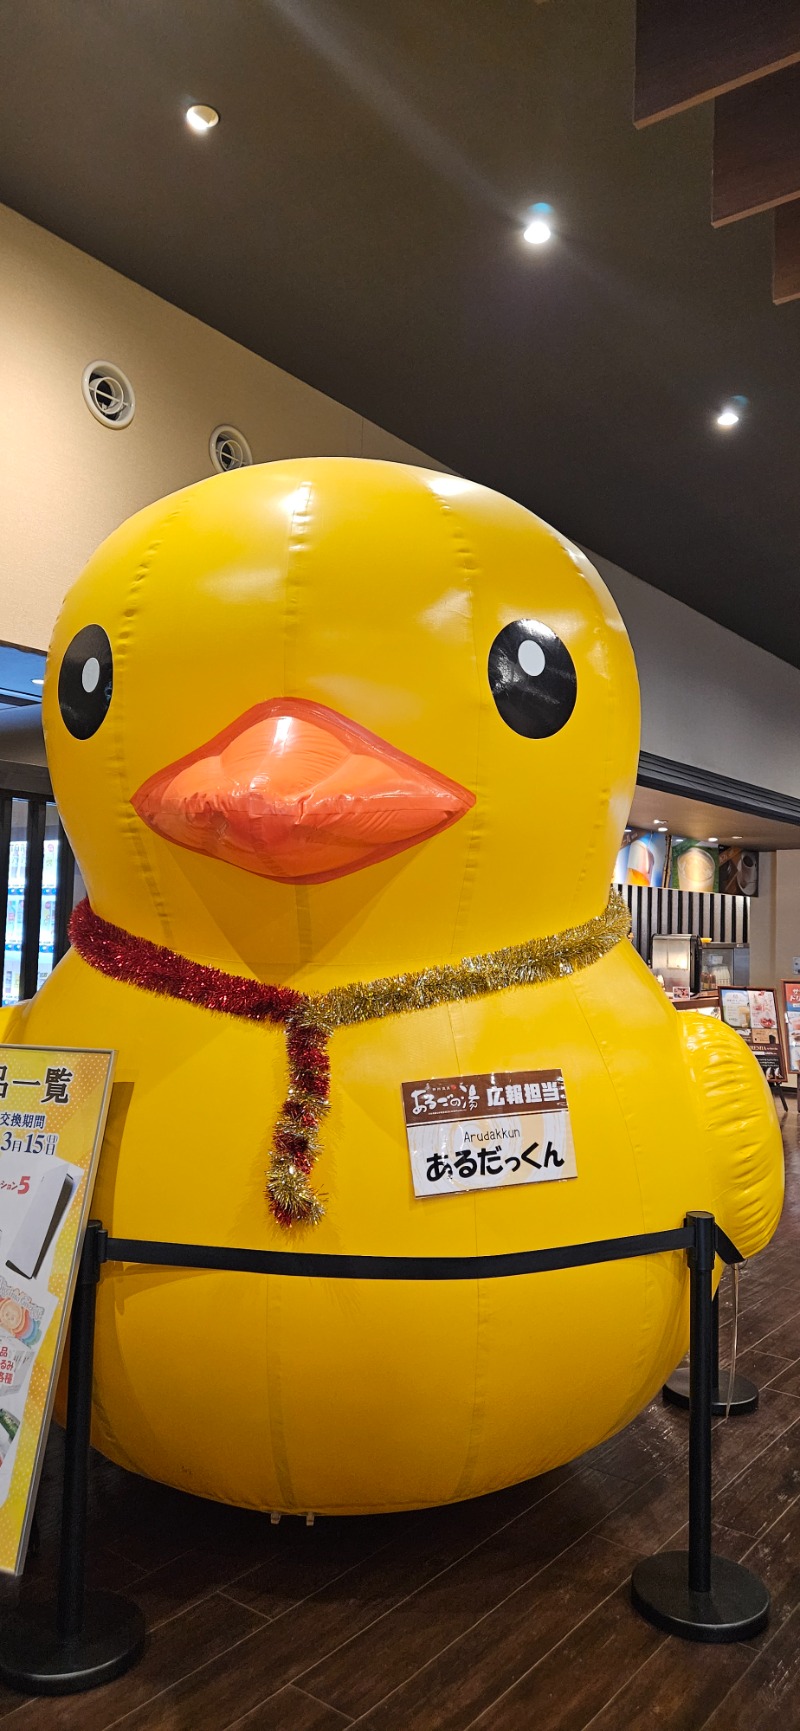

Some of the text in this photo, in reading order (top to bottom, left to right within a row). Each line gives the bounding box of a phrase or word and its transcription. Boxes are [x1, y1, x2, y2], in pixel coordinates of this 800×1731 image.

[486, 1081, 561, 1107] 広報担当
[0, 1111, 46, 1129] 交換期間
[463, 1128, 521, 1144] Arudakkun
[426, 1141, 565, 1182] あるだっくん
